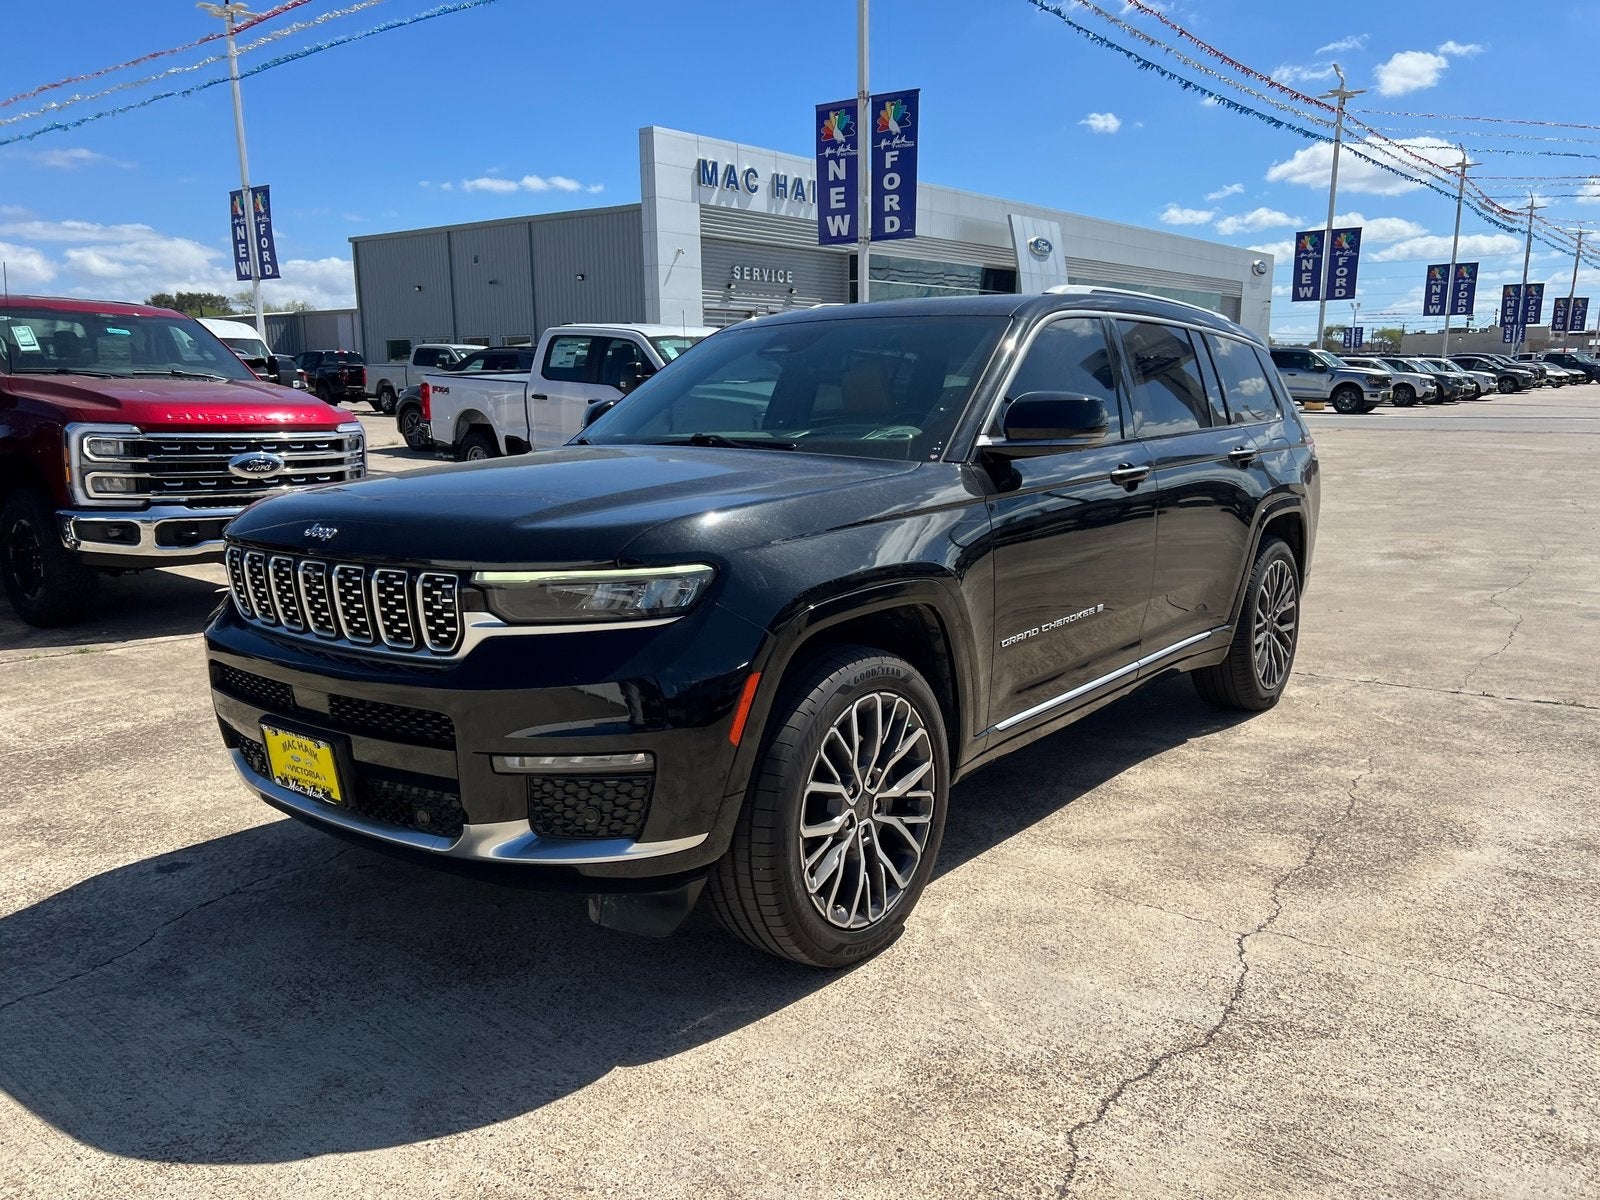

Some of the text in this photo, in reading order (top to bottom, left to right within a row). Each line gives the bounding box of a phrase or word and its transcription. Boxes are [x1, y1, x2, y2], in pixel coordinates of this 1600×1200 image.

[699, 158, 816, 204] MAC HAI
[883, 150, 901, 234] FORD
[826, 158, 851, 237] NEW
[236, 225, 250, 276] NEW
[259, 223, 273, 276] FORD
[733, 265, 793, 284] SERVICE
[1298, 258, 1314, 298] NEW
[1334, 256, 1349, 298] FORD
[1428, 284, 1442, 314] NEW
[1457, 283, 1468, 314] FORD
[1504, 300, 1515, 323] NEW
[1527, 299, 1537, 323] FORD
[1554, 310, 1564, 330] NEW
[432, 385, 450, 395] FX4
[246, 459, 272, 472] Ford
[304, 522, 338, 541] Jeep
[1001, 627, 1039, 648] GRAND
[1041, 606, 1096, 632] CHEROKEE
[853, 665, 902, 685] GOODYEAR
[282, 739, 319, 763] MAC HAIK
[291, 764, 321, 781] VICTORIA
